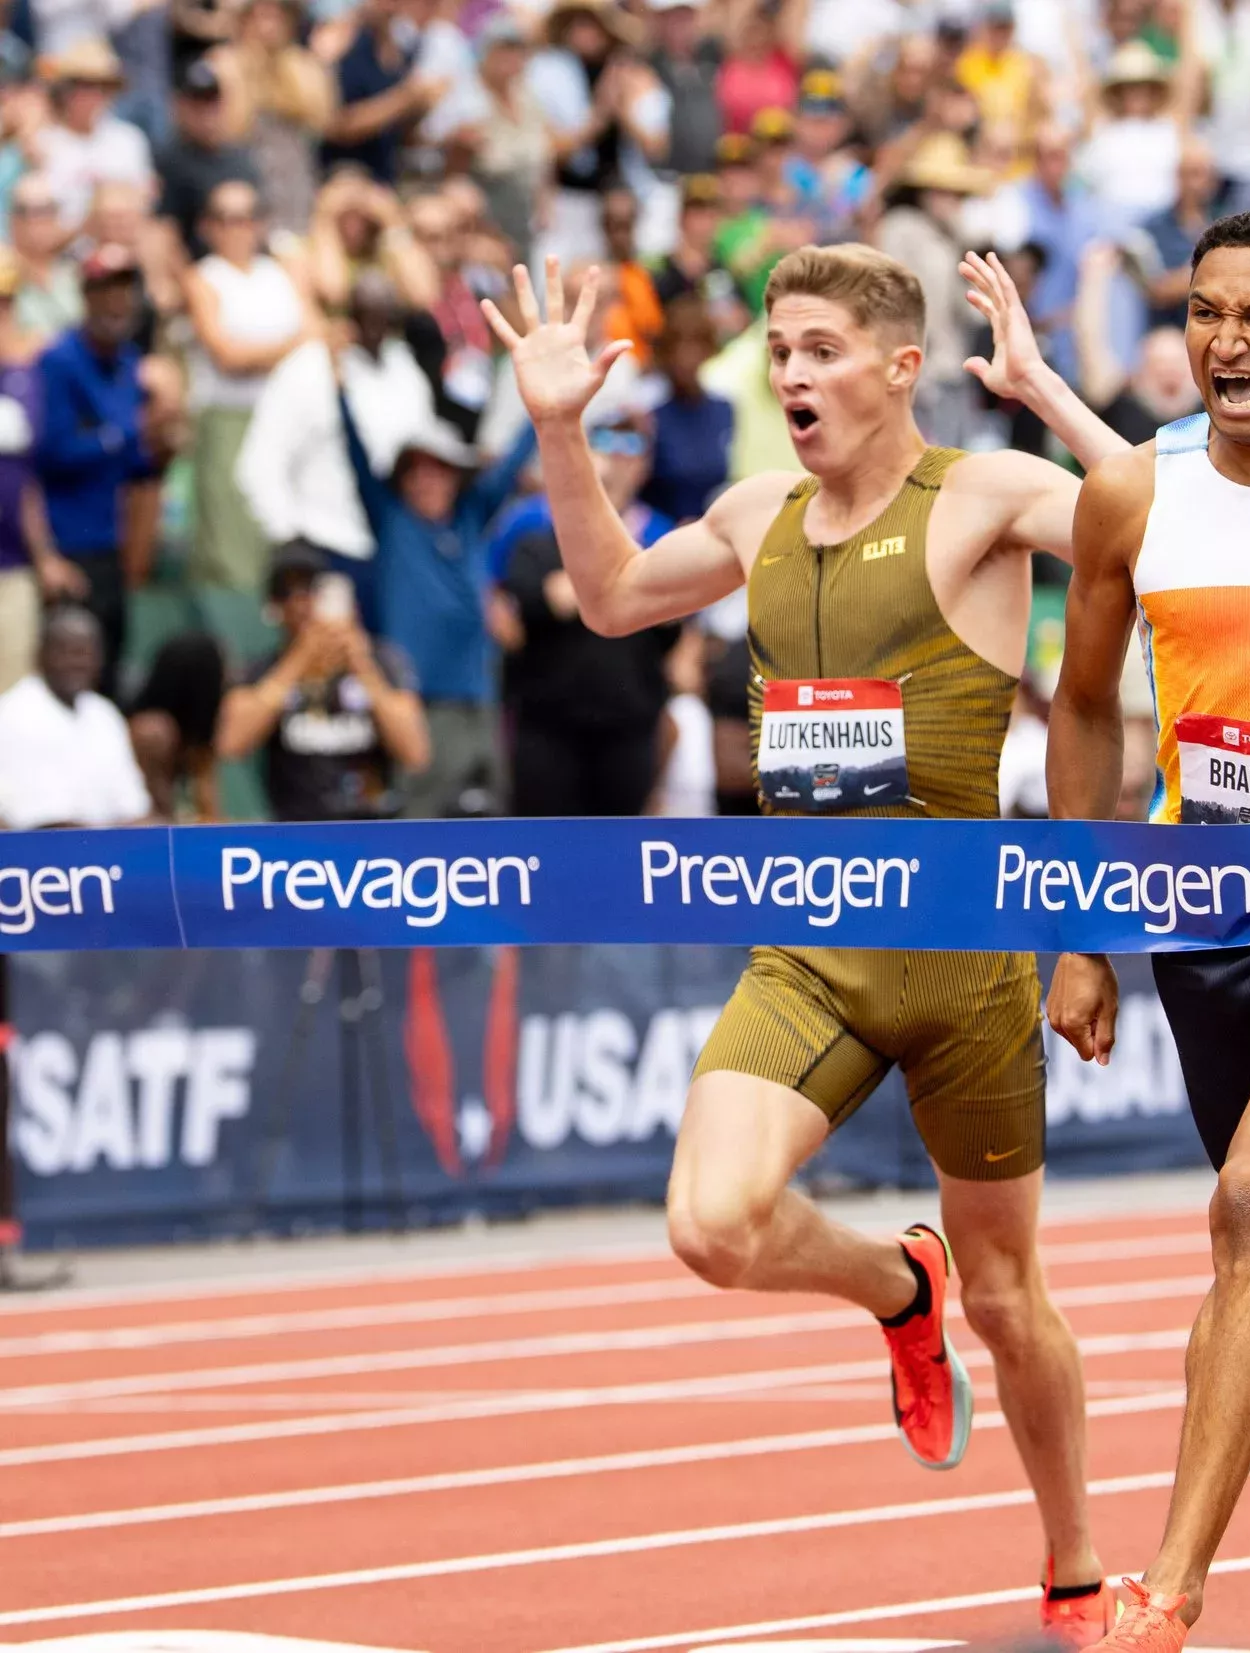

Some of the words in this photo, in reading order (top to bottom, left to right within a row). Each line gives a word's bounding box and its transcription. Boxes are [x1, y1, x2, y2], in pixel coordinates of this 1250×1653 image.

[815, 689, 854, 701] TOYOTA
[768, 720, 893, 749] LUTKENHAUS
[6, 1028, 256, 1175] SATF
[517, 1007, 722, 1149] USA
